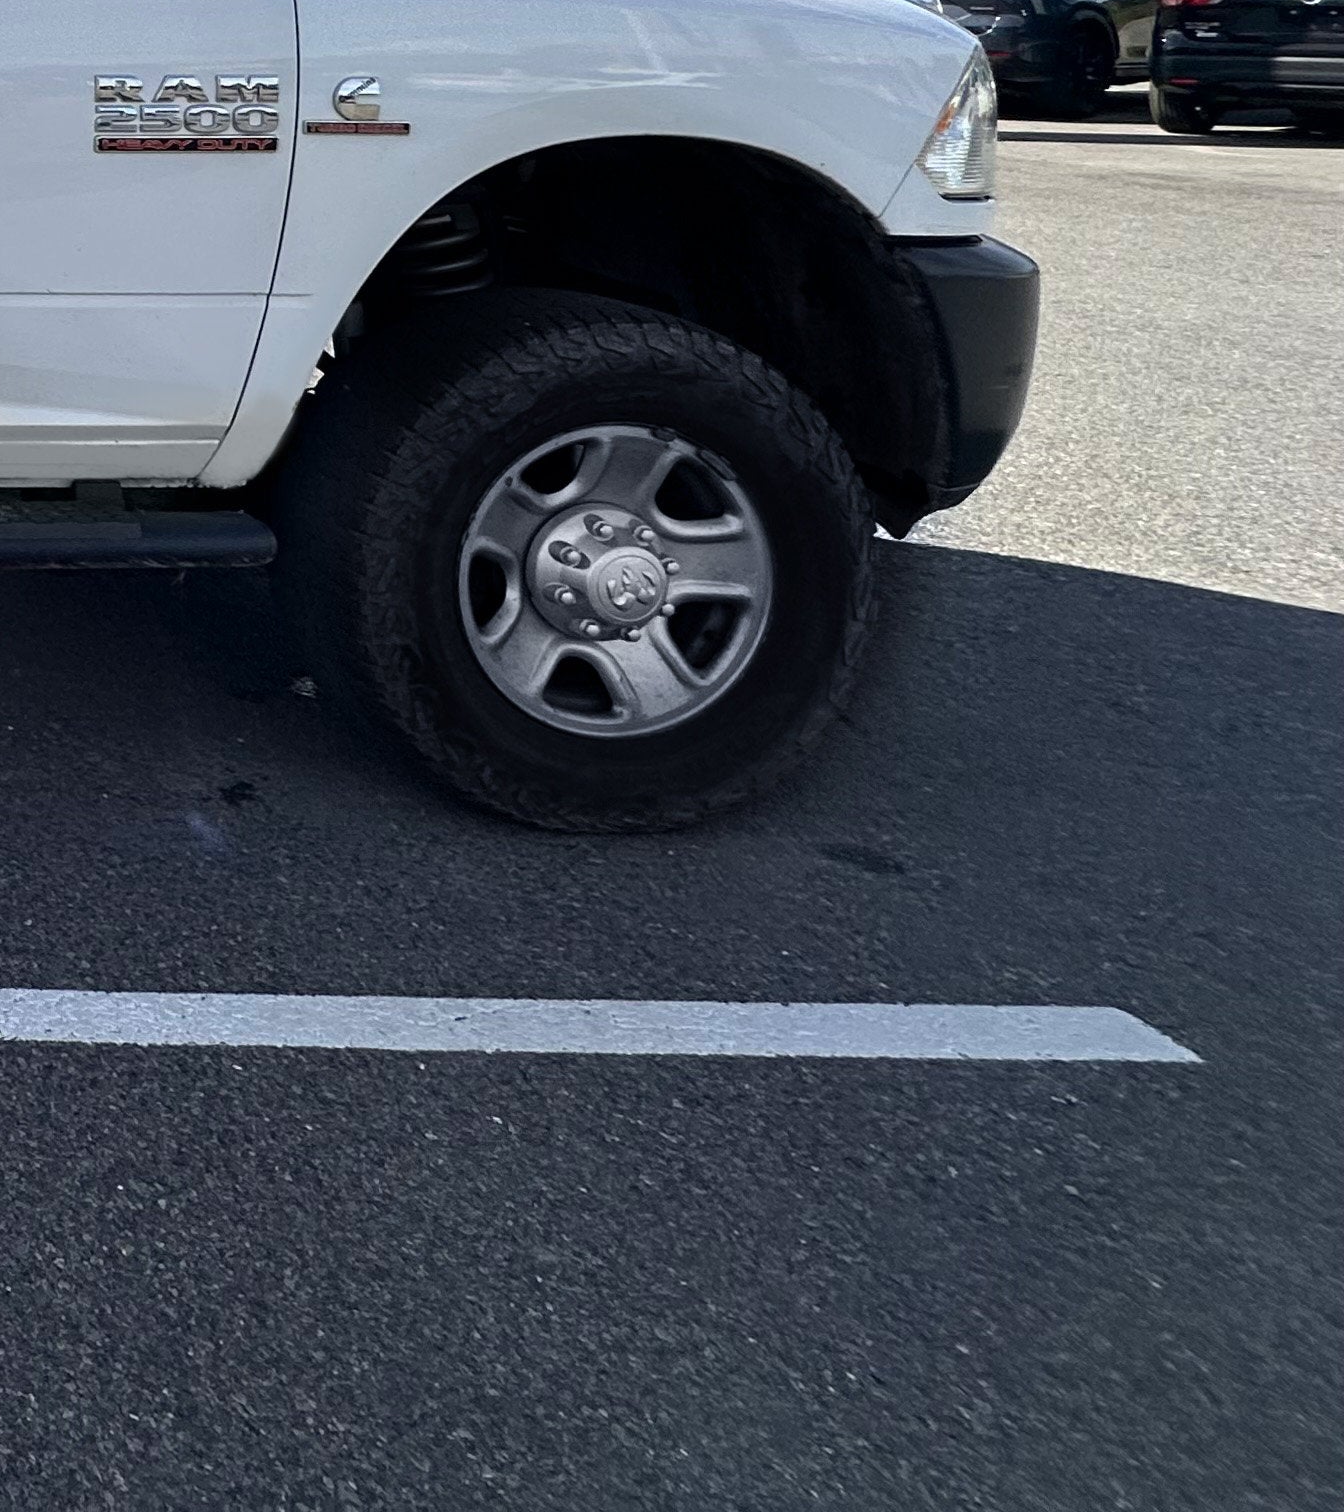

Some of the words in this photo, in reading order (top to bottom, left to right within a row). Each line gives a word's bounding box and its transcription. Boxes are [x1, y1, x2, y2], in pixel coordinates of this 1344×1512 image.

[94, 74, 279, 103] RAM
[94, 104, 279, 133] 2500
[101, 138, 193, 150] HEAVY
[196, 138, 273, 150] DUTY
